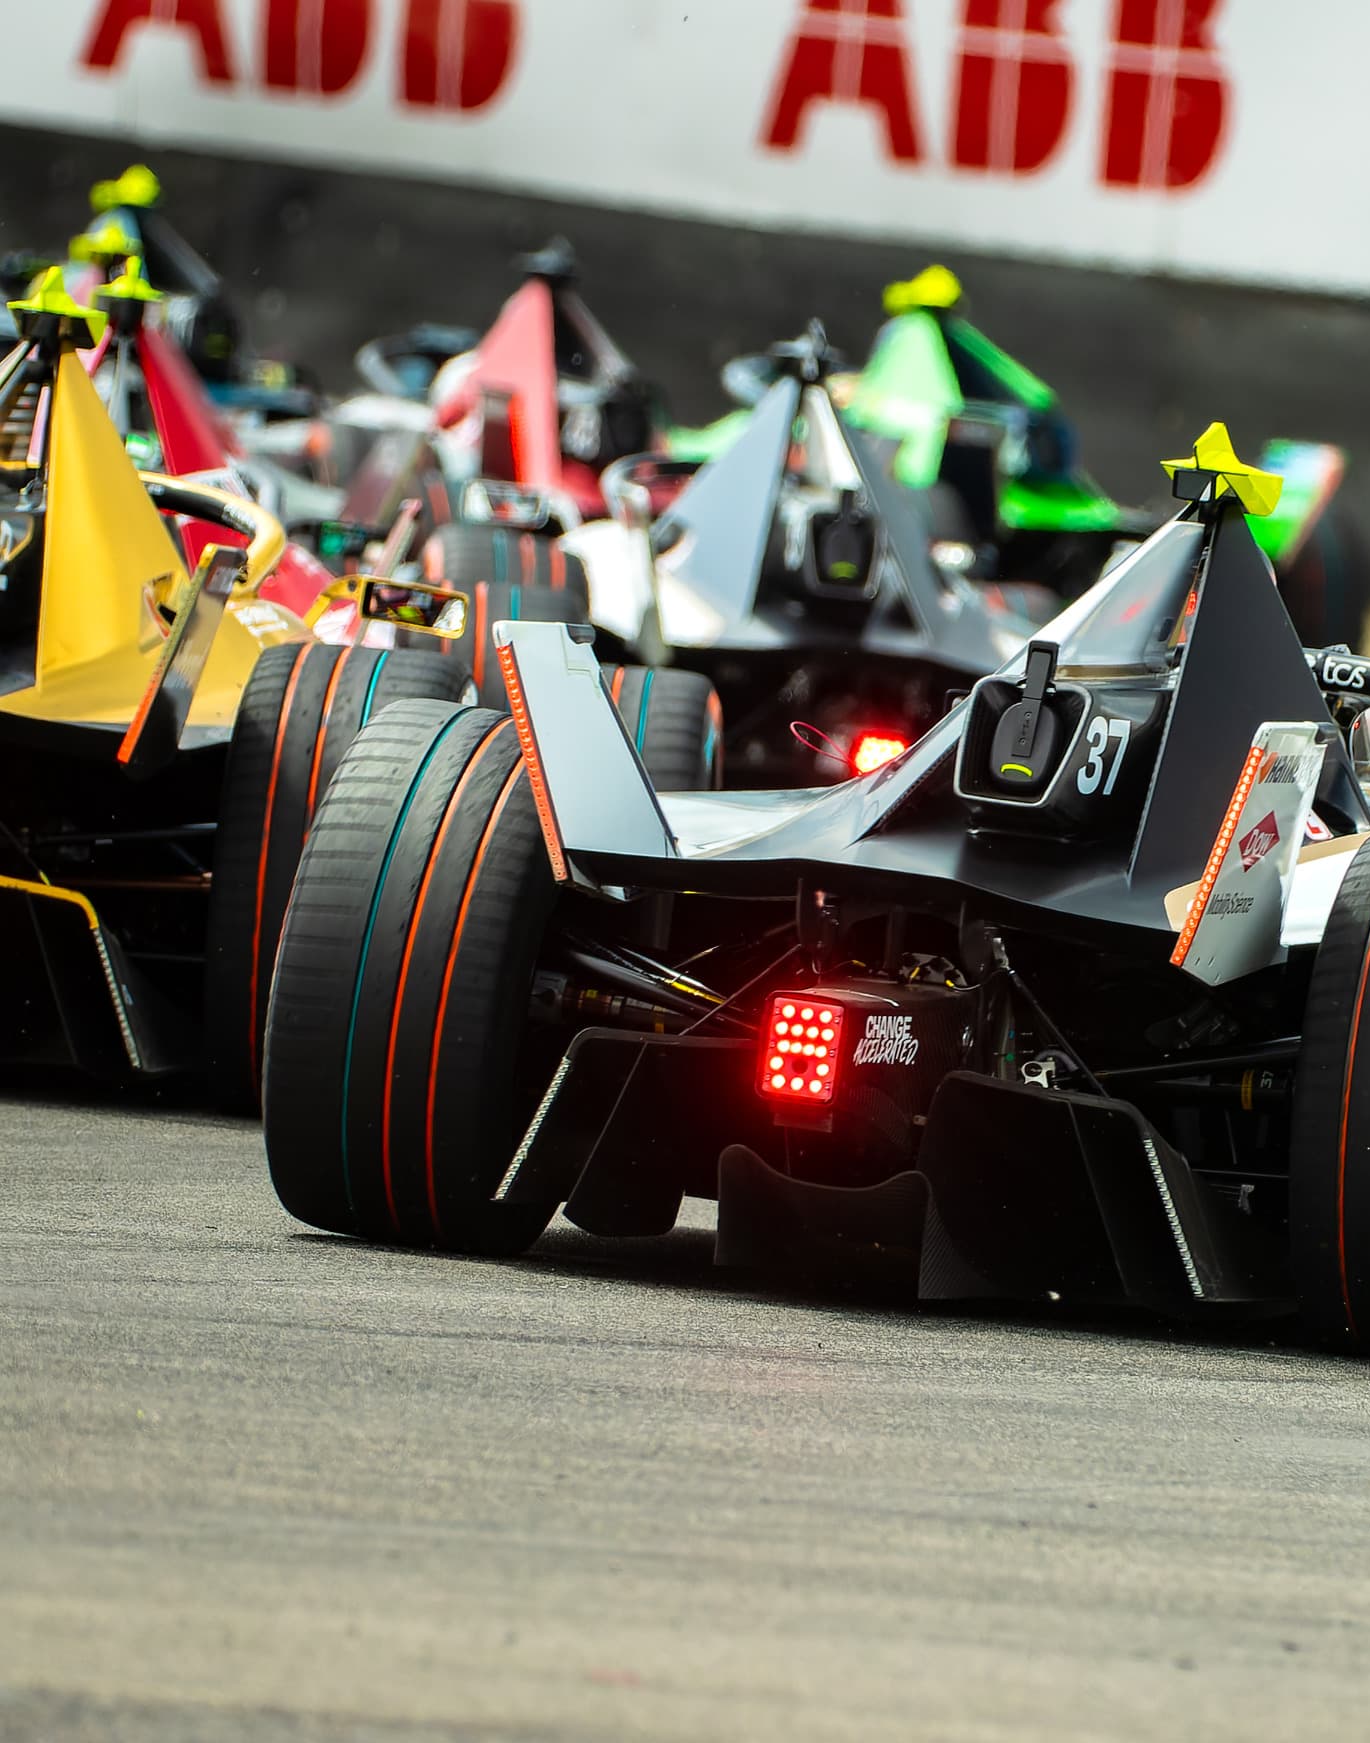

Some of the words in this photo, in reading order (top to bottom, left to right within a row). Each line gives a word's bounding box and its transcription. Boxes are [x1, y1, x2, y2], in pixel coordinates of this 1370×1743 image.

[756, 0, 1228, 192] ABB
[1322, 655, 1367, 689] tcs
[1077, 715, 1131, 795] 37
